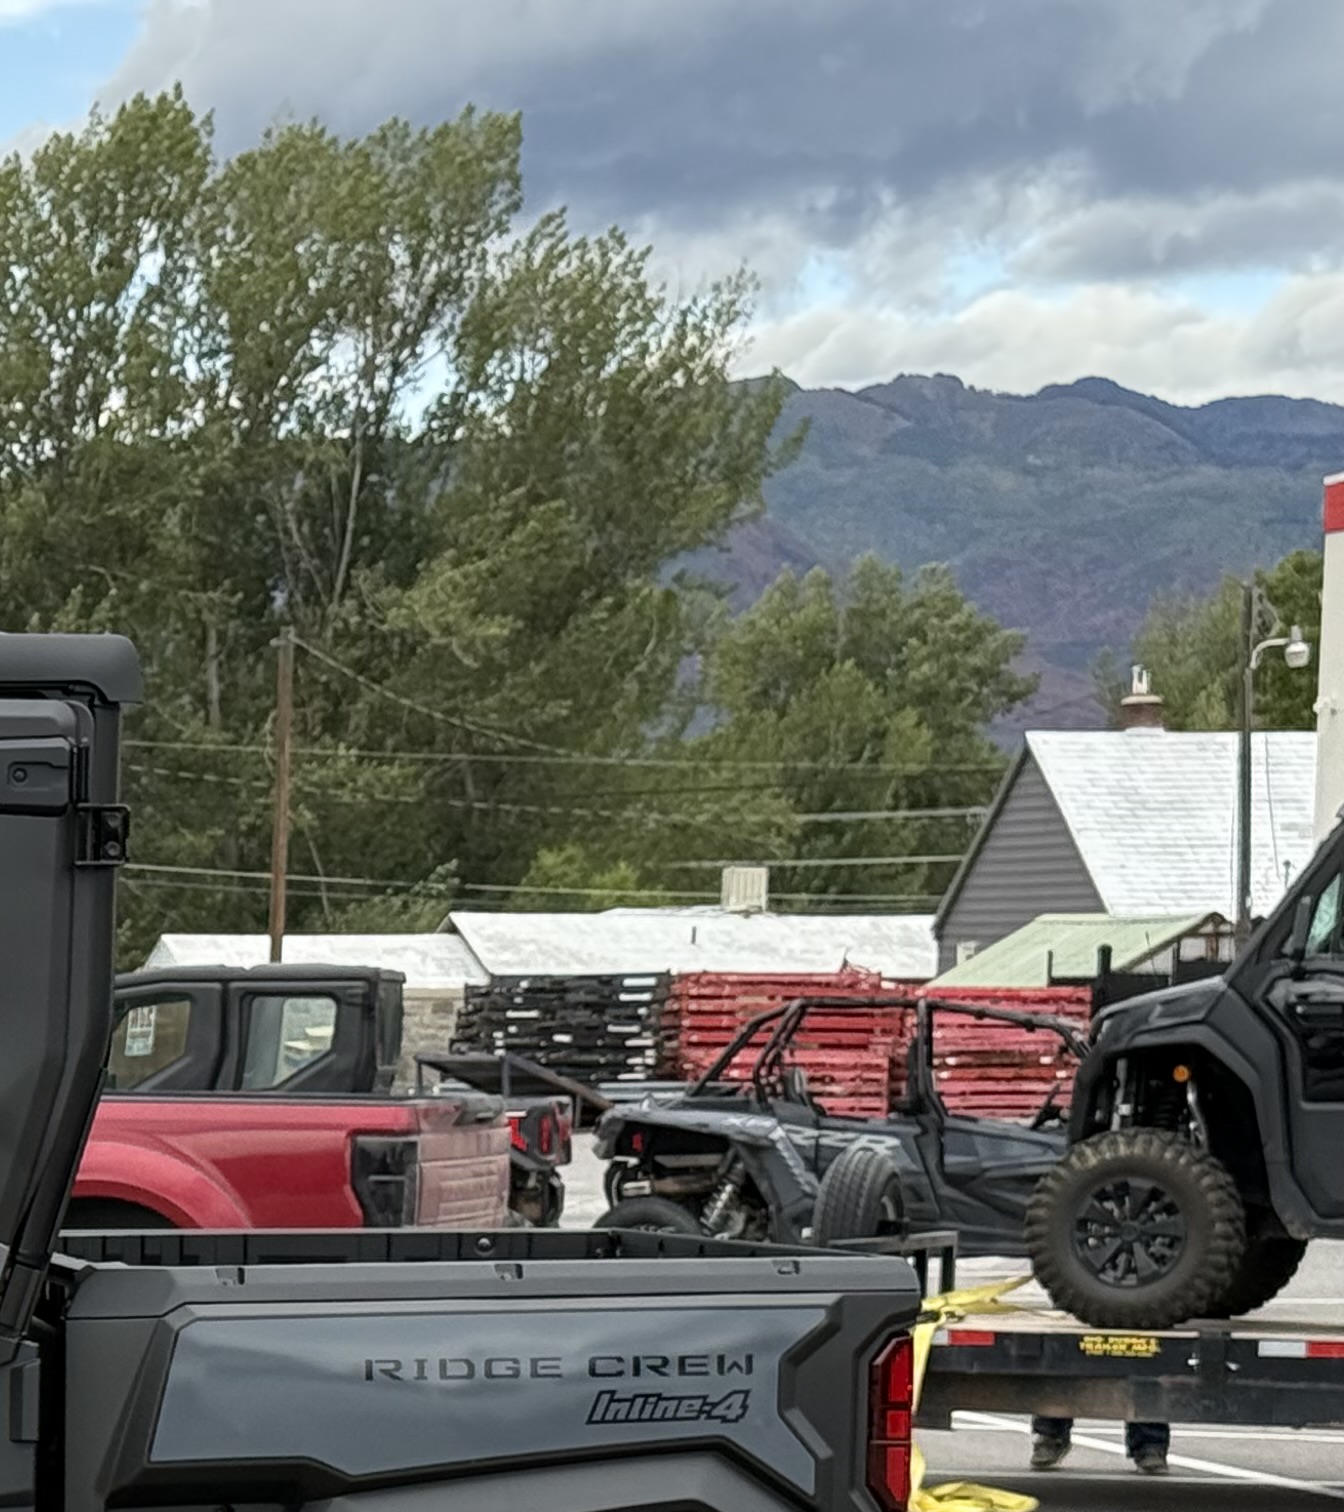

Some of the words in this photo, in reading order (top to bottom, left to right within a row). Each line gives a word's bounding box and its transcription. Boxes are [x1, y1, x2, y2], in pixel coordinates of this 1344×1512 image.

[364, 1357, 563, 1381] RIDGE
[588, 1354, 754, 1377] CREW
[585, 1389, 752, 1425] Inline-4
